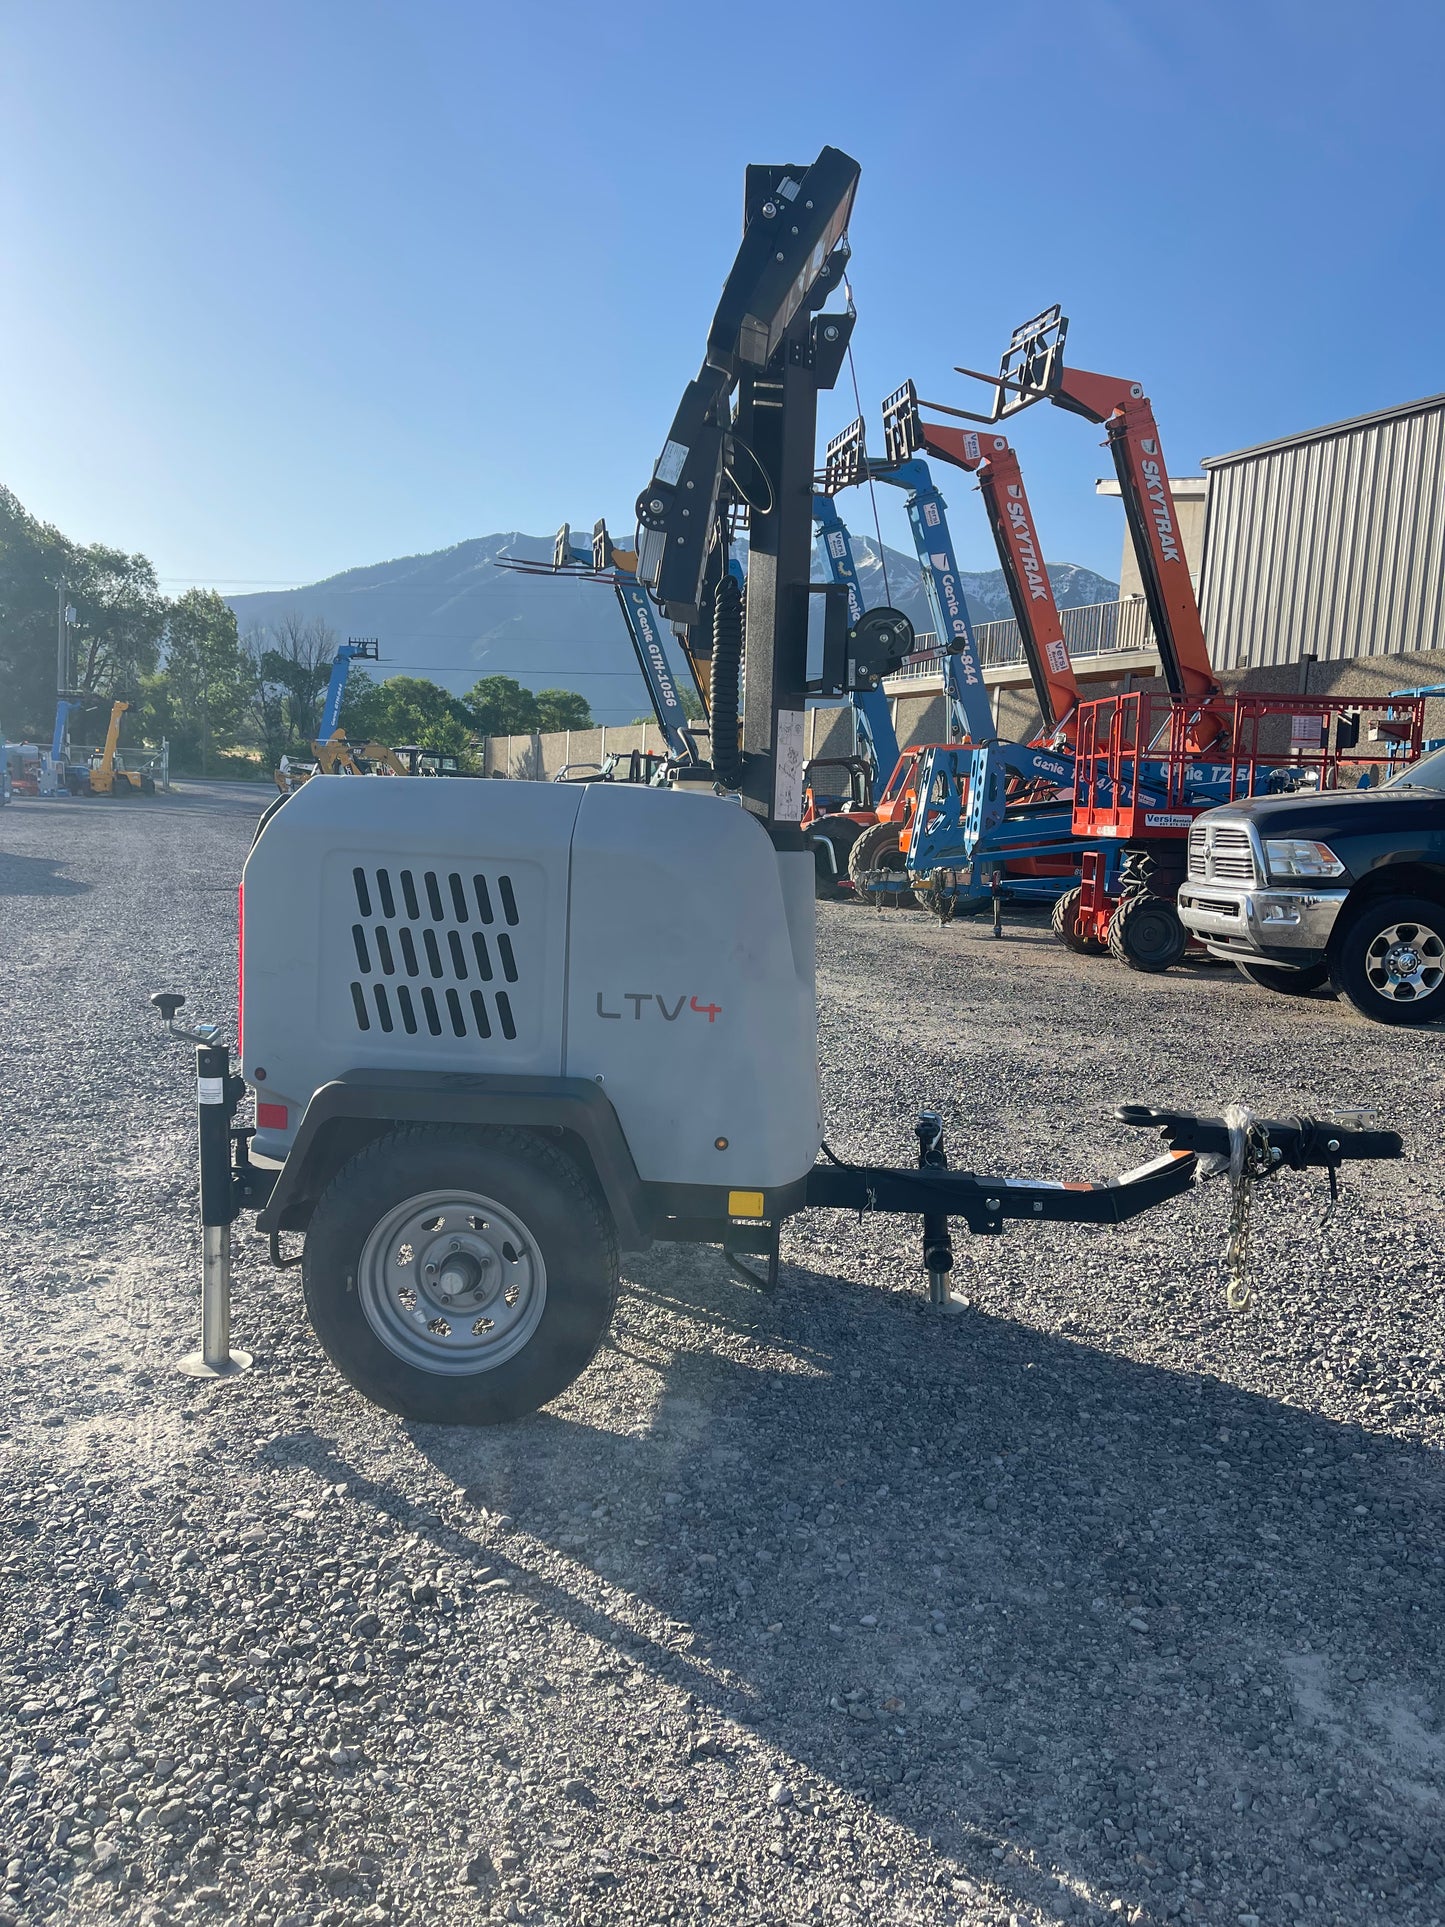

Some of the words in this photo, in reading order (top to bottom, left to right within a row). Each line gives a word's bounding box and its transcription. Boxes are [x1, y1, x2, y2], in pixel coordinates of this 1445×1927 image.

[970, 433, 980, 458] Versi
[1141, 459, 1180, 562] SKYTRAK
[835, 532, 846, 556] Versi
[1006, 502, 1048, 601] SKYTRAK
[942, 574, 959, 616] Genie
[636, 607, 654, 643] Genie
[648, 644, 677, 707] GTH-1056
[1055, 641, 1068, 669] Versi
[1032, 755, 1065, 775] Genie
[1159, 762, 1204, 781] Gnie
[1211, 766, 1258, 782] TZ5
[1147, 814, 1173, 823] Versi
[596, 991, 722, 1023] LTV4
